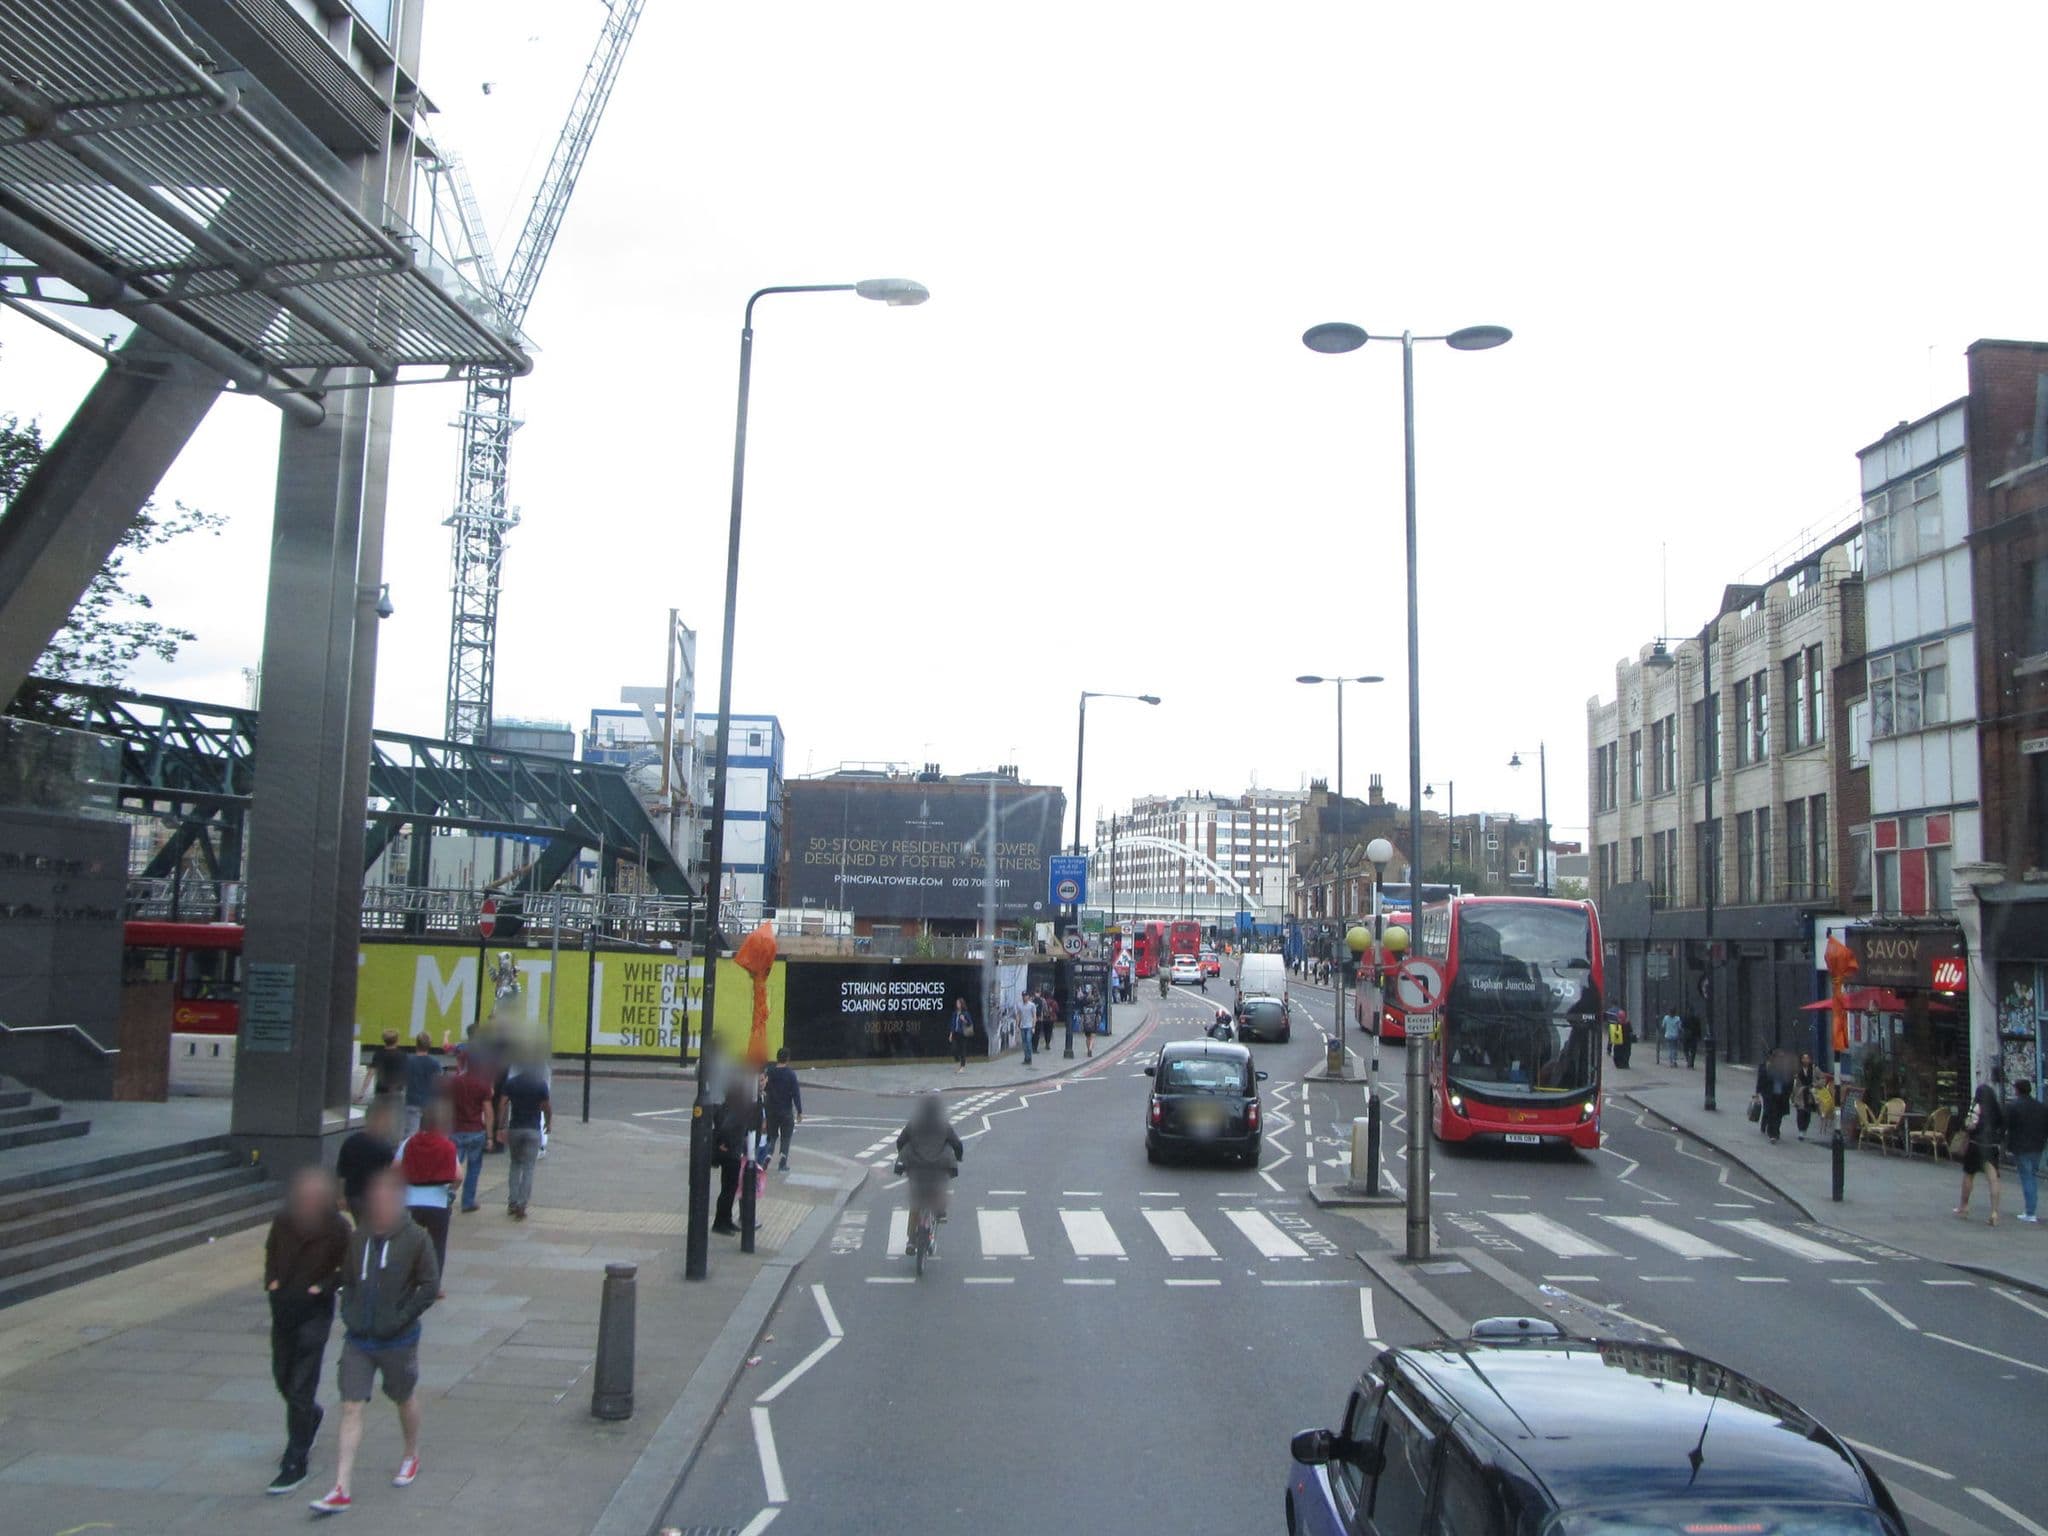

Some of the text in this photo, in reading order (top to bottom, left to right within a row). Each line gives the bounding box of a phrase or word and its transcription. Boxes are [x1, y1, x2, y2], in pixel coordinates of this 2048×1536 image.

[810, 838, 1036, 856] 50-STOREY RESIDENTIAL OWER
[804, 852, 876, 866] DESIGNED
[880, 855, 898, 867] BY
[902, 855, 956, 869] FOSTER
[970, 857, 1042, 871] PATNERS
[833, 874, 943, 887] PRINCIPALTOWER.COM
[952, 877, 969, 887] 020
[995, 878, 1010, 888] 5111
[1065, 941, 1080, 949] 30
[1866, 939, 1919, 959] SAVOY
[624, 962, 687, 983] WHERE
[1934, 962, 1962, 988] illy
[622, 984, 702, 1005] THE CITY
[841, 982, 945, 995] STRIKING RESIDENCES
[1472, 977, 1574, 997] Clapham Junction 35
[842, 998, 944, 1012] SOARING 50 STOREYS
[621, 1005, 680, 1026] MEETS
